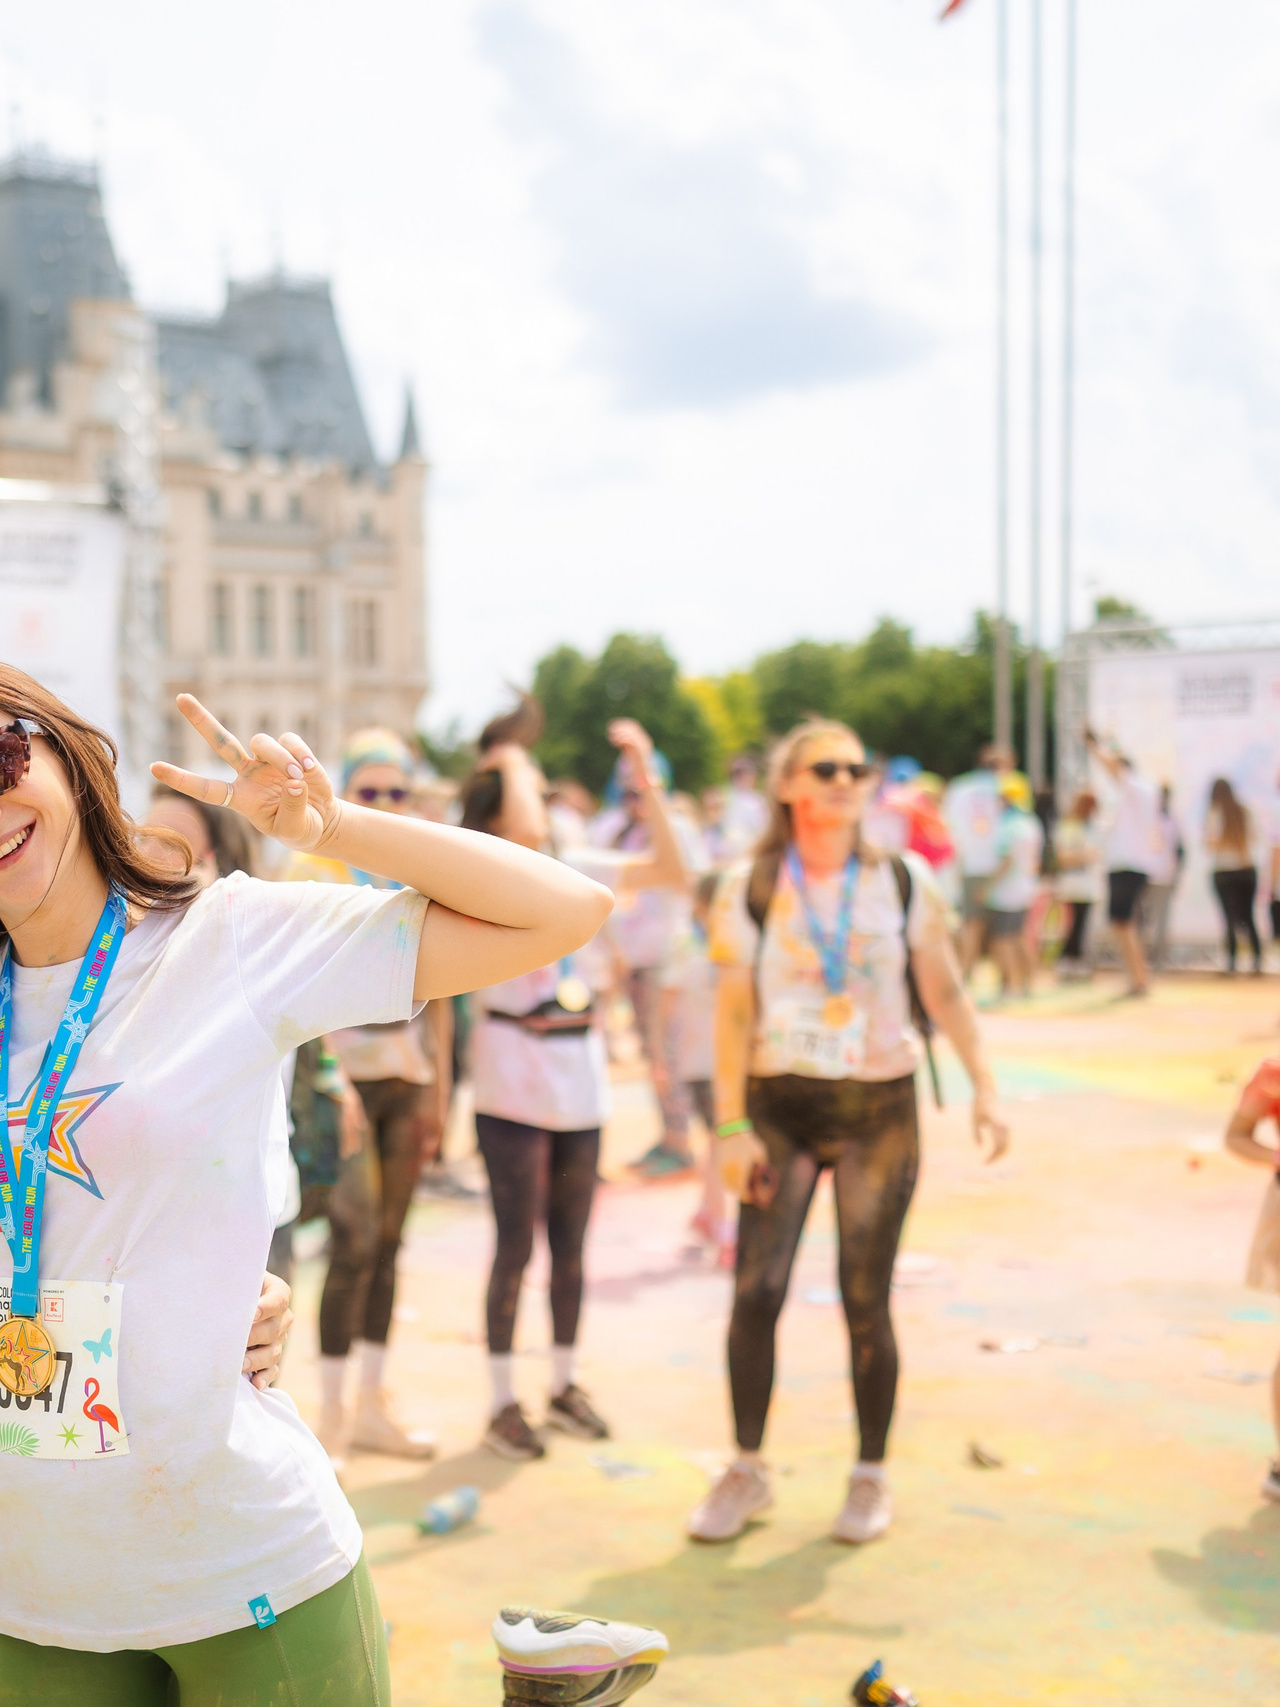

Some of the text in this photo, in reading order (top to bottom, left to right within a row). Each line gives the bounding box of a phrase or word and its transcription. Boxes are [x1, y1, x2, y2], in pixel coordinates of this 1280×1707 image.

[83, 932, 113, 991] THE COLOR RUN
[37, 1054, 68, 1115] THE COLOR RUN
[0, 1184, 14, 1202] RUN
[23, 1206, 35, 1236] COLOR
[22, 1237, 33, 1253] THE
